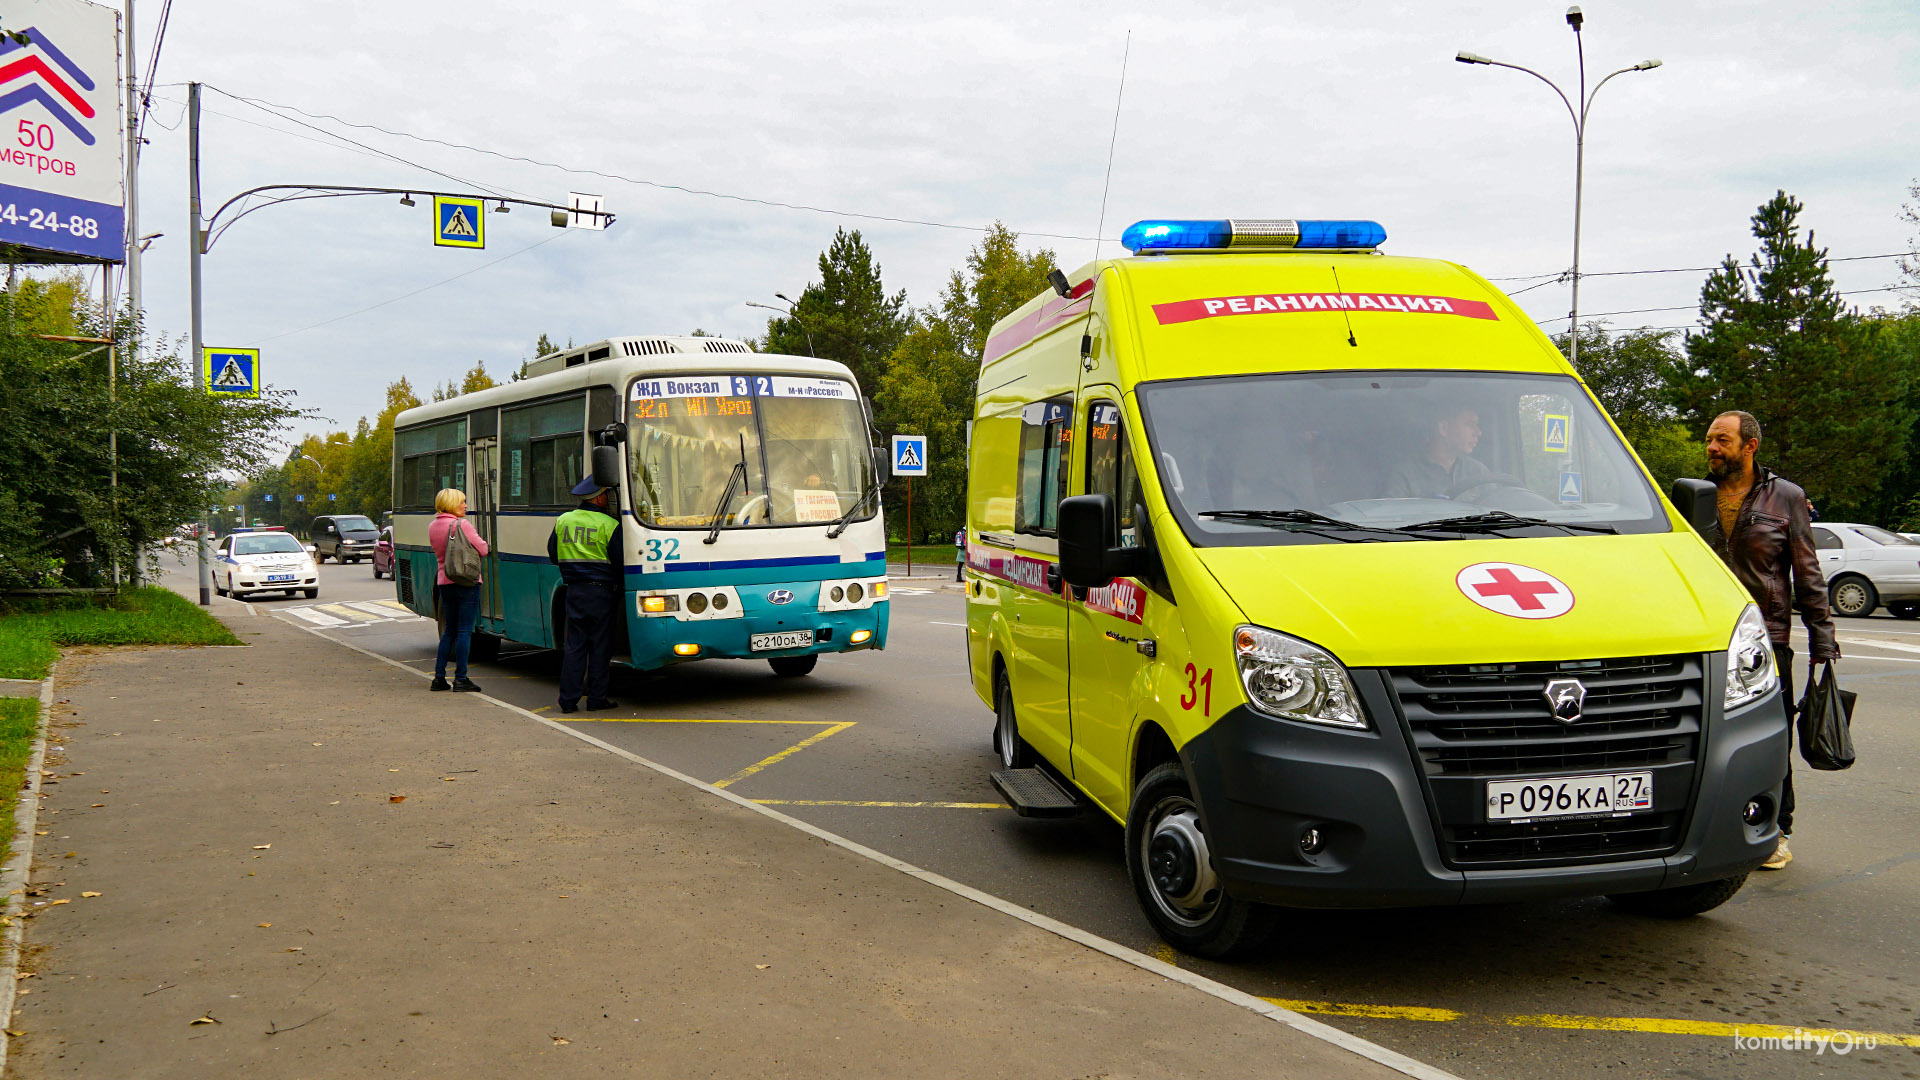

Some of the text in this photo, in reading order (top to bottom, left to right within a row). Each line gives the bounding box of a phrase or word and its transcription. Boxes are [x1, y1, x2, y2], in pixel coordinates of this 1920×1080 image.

[17, 119, 54, 151] 50
[0, 148, 76, 176] метров
[0, 203, 98, 239] 4-24-88
[1204, 295, 1455, 314] РЕАНИМАЦИЯ
[637, 382, 662, 397] ЖД
[667, 381, 719, 394] Вокзал
[646, 538, 680, 561] 32
[1181, 662, 1213, 718] 31
[1500, 777, 1643, 814] Р096КА 27
[1616, 799, 1634, 807] RUS
